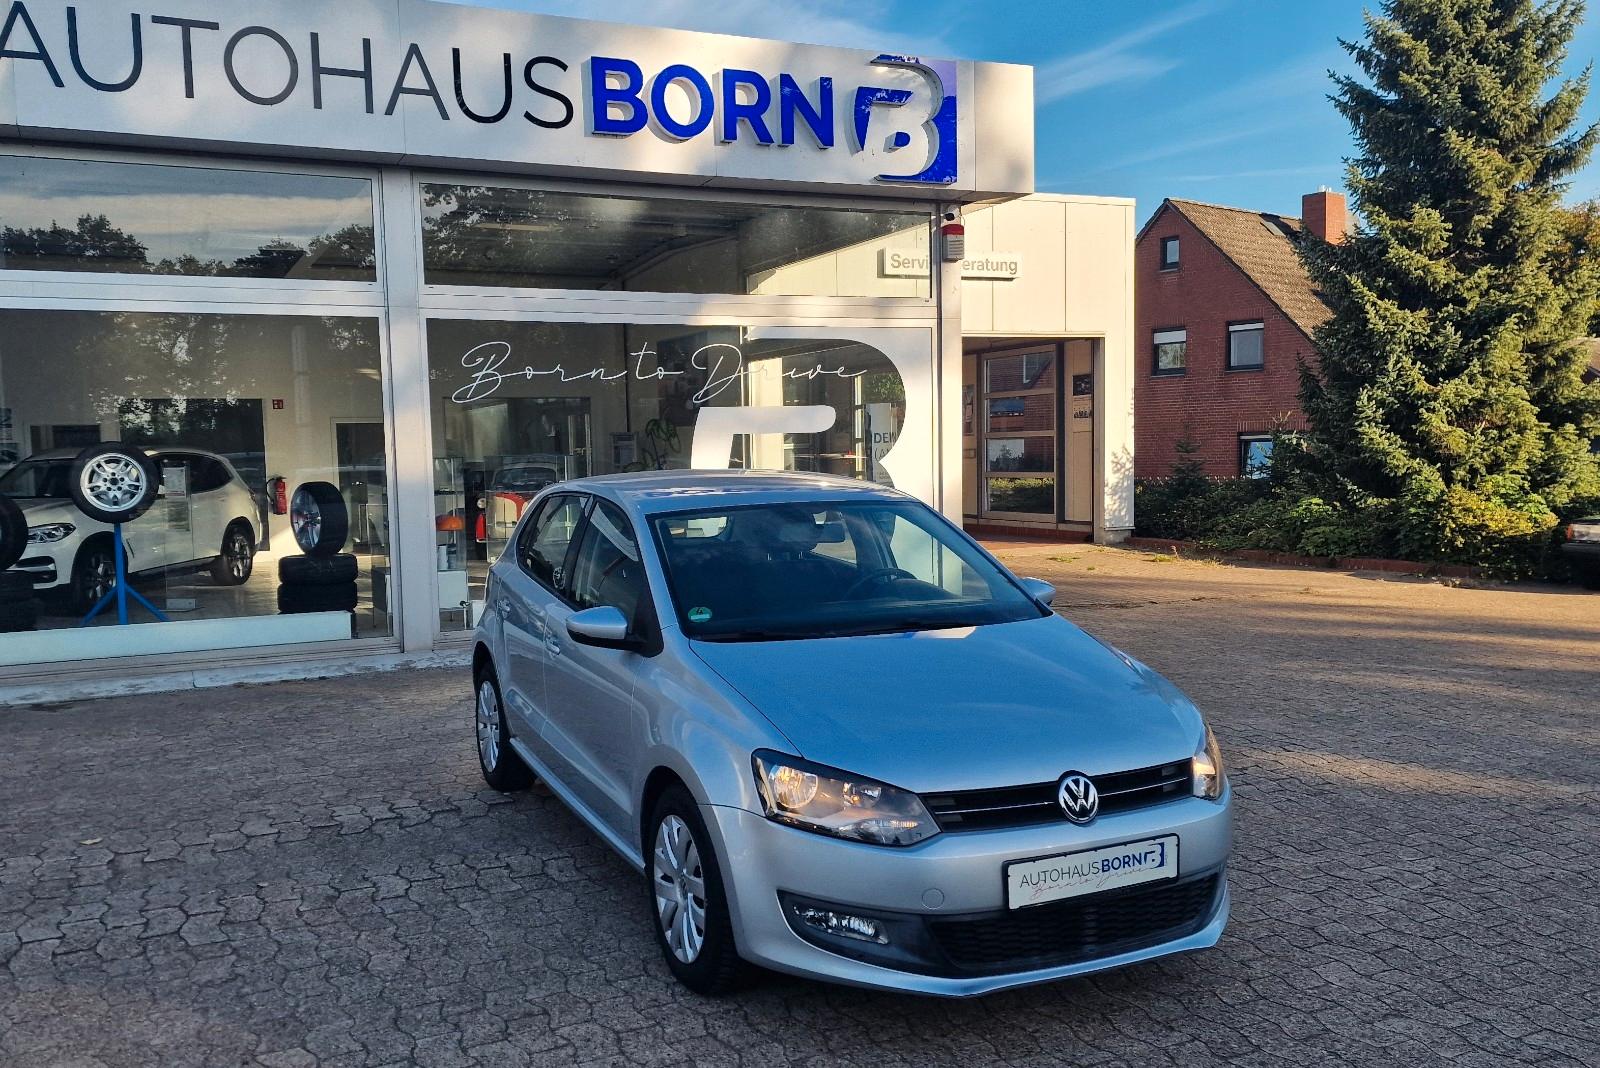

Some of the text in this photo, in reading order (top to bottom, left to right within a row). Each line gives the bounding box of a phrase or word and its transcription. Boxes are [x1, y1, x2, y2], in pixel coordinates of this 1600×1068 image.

[452, 341, 867, 403] Born to Drive
